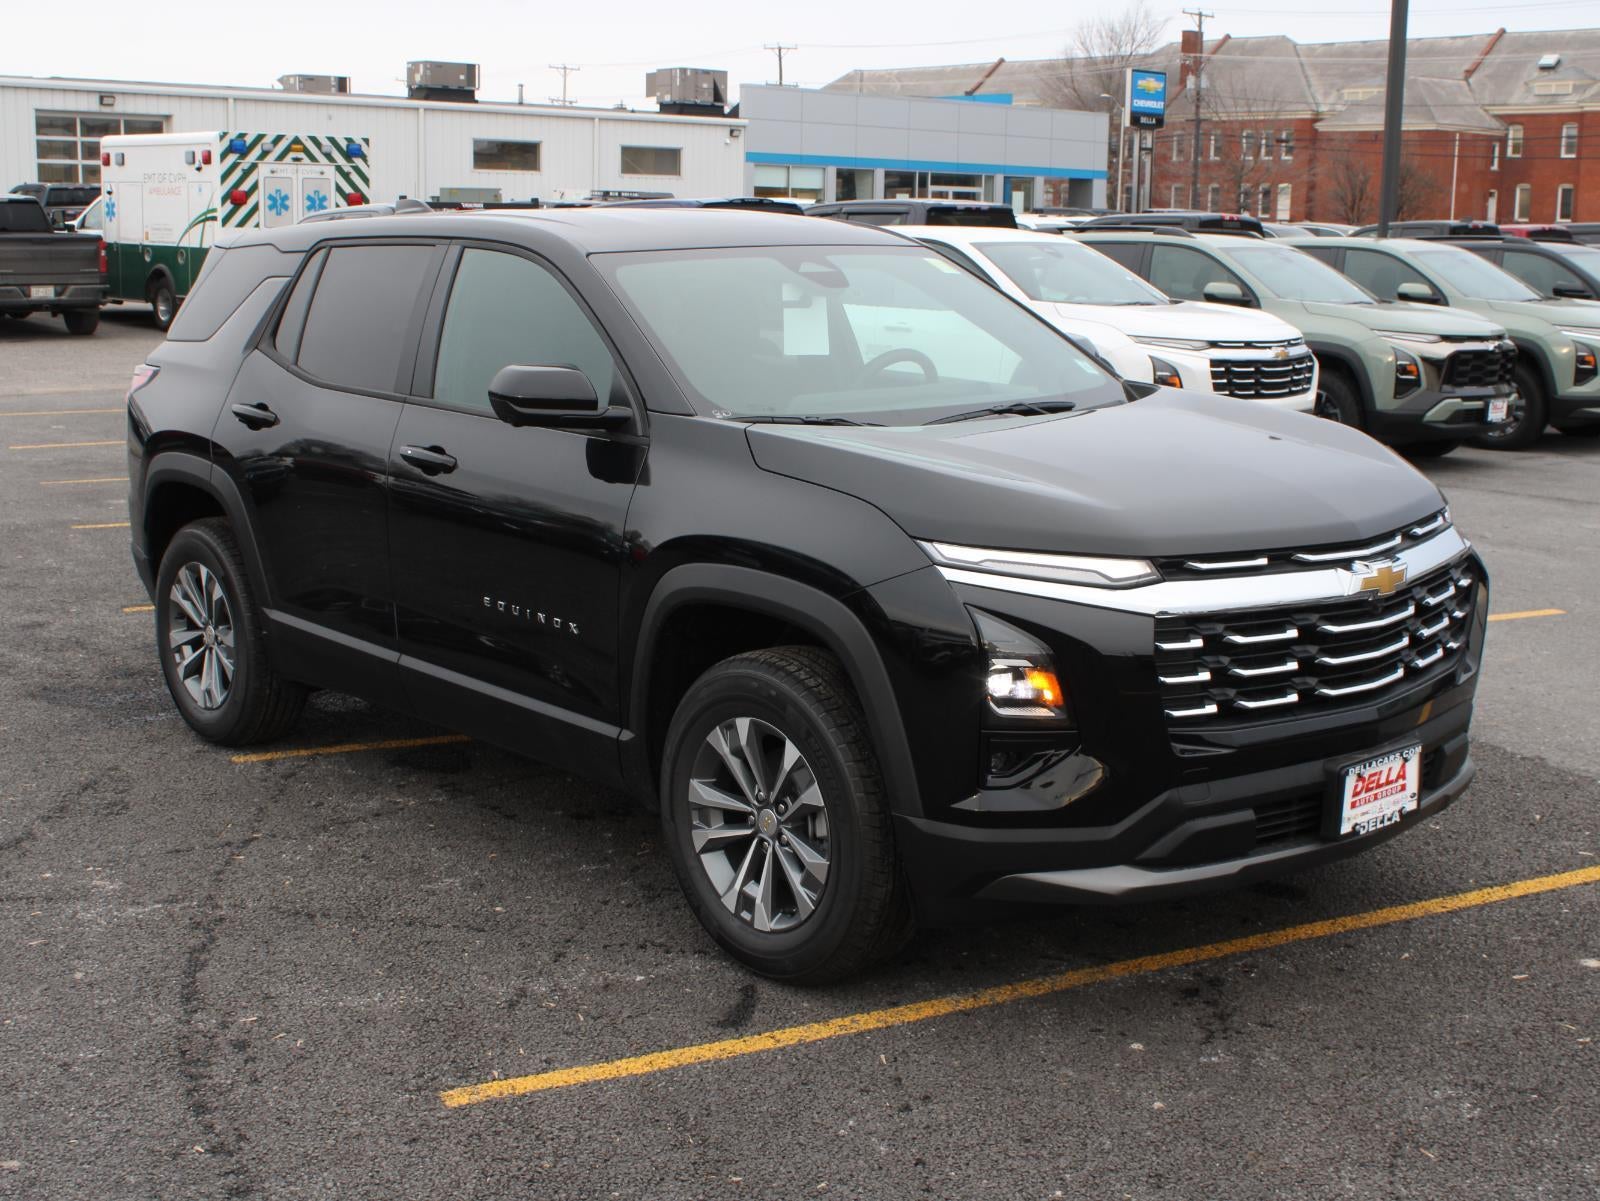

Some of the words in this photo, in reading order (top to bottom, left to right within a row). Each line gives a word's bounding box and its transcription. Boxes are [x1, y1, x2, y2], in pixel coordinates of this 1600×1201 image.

[1133, 99, 1165, 109] CHEVROLET
[1140, 116, 1156, 124] DELLA
[143, 172, 157, 184] EMT
[483, 596, 579, 634] EQUINOX
[1348, 745, 1422, 776] DELLACARS.COM
[1352, 763, 1407, 798] DELLA
[1355, 795, 1375, 808] AUTO
[1377, 785, 1402, 799] GROUP
[1359, 809, 1400, 835] DELLA
